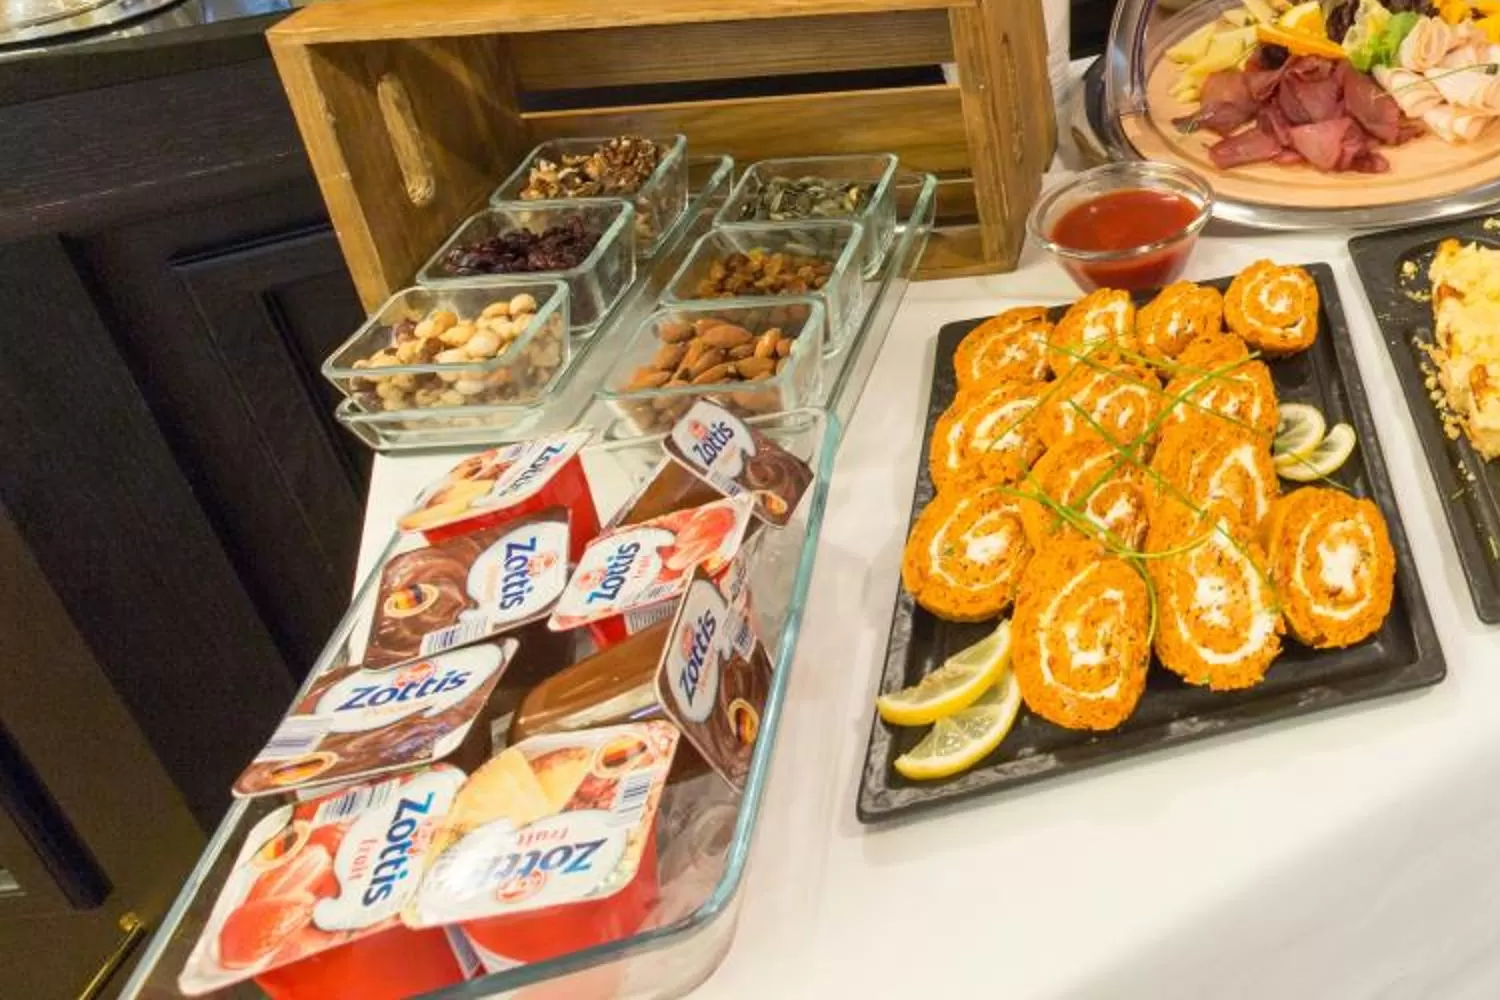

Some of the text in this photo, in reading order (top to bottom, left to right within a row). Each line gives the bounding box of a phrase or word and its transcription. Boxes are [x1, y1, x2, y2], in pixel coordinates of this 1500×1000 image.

[692, 421, 734, 466] Zottis
[500, 536, 537, 610] Zottis
[586, 541, 641, 604] Zottis
[334, 670, 471, 712] Zottis
[679, 609, 716, 707] Zottis
[362, 792, 435, 907] Zottis
